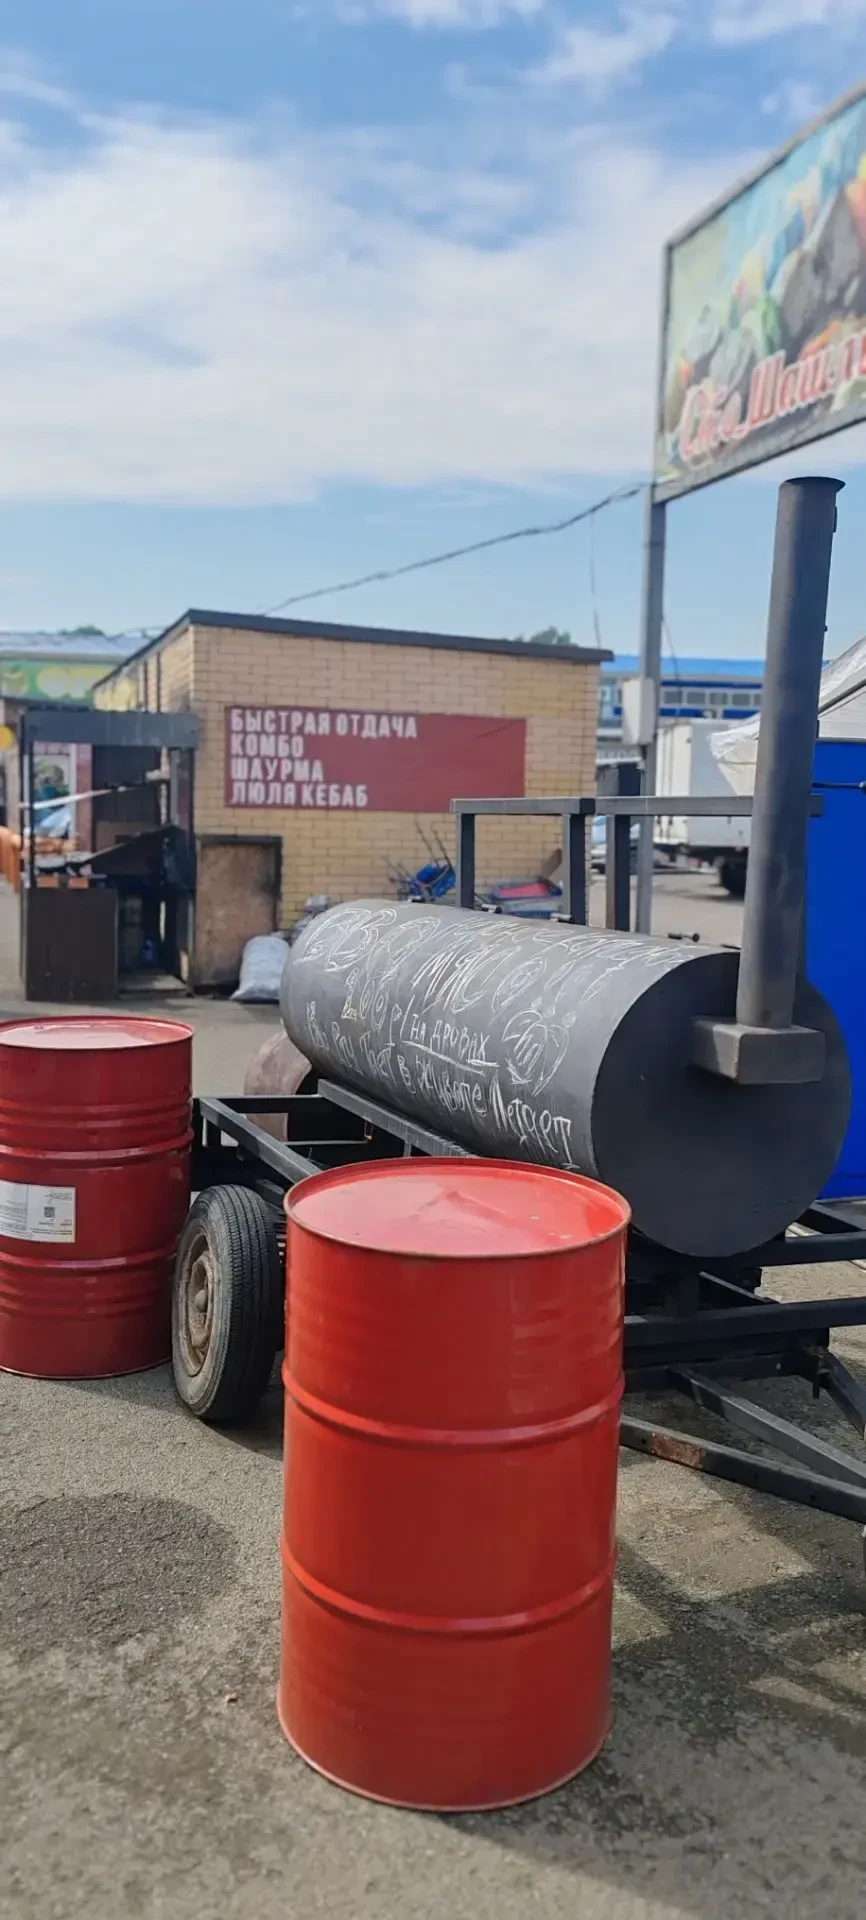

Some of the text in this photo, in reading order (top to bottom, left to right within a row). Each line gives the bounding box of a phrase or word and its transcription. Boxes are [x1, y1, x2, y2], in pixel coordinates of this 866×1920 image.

[230, 708, 417, 739] БЫСТРАЯ ОТДАЧА
[230, 734, 305, 757] КОМБО
[230, 758, 325, 783] ШАУРМА
[230, 782, 369, 808] ЛЮЛЯ КЕБАБ
